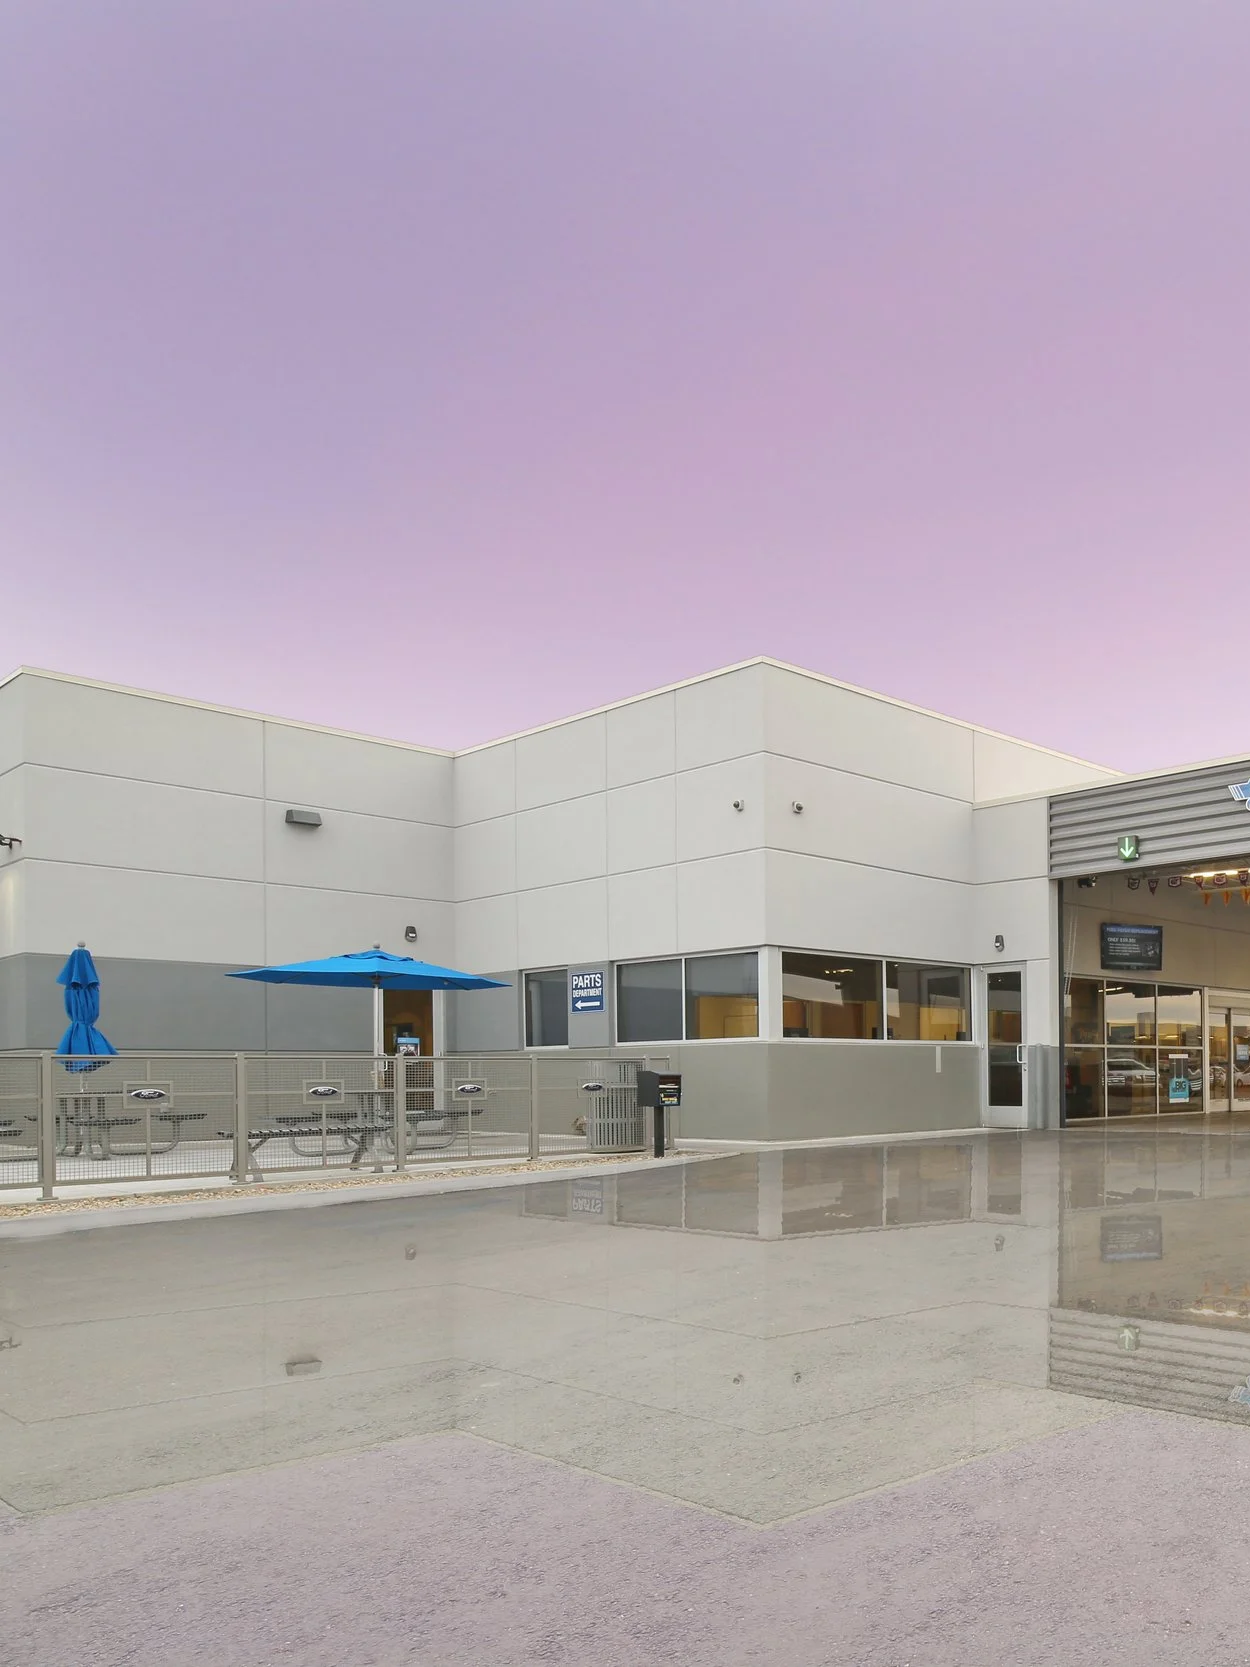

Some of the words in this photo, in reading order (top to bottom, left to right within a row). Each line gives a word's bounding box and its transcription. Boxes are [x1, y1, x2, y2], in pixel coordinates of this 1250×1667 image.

[572, 974, 602, 989] PARTS
[572, 987, 602, 998] DEPARTMENT
[1175, 1081, 1186, 1090] BIG
